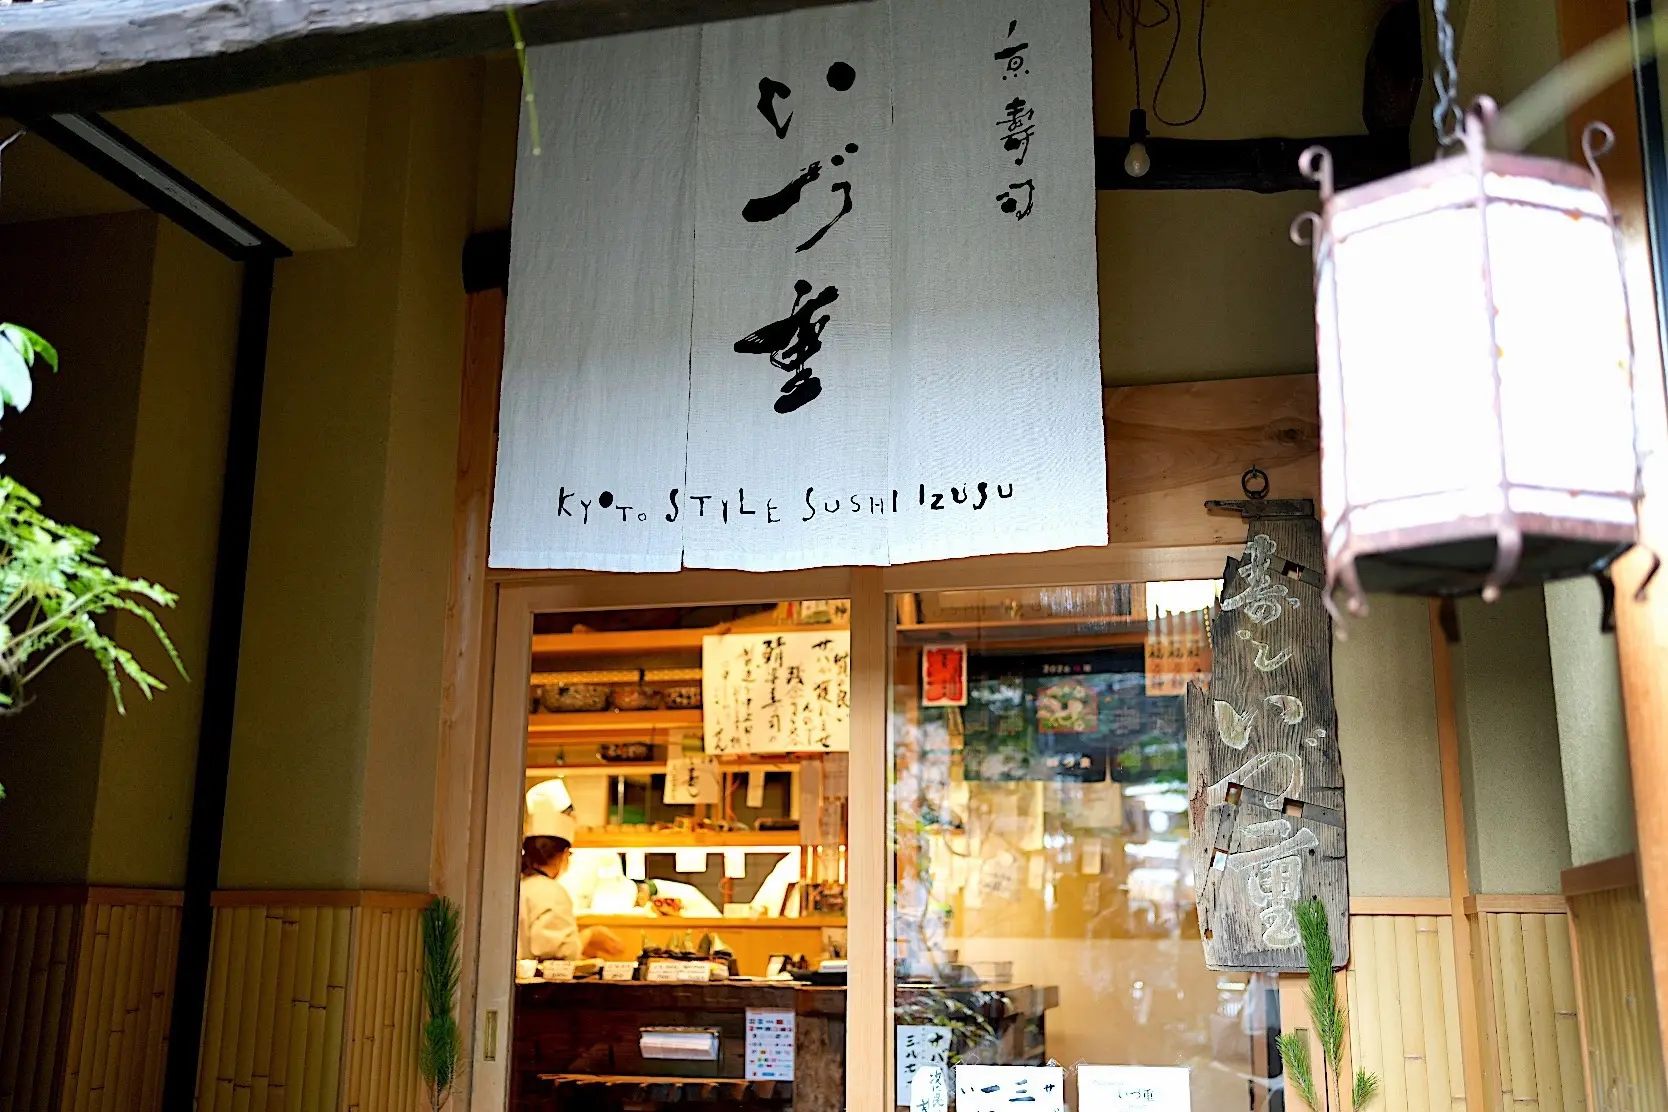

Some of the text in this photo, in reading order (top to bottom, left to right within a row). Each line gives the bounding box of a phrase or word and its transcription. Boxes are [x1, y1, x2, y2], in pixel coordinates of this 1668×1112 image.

[558, 481, 1013, 525] KYOTO STYLE SUSHI IZUSU
